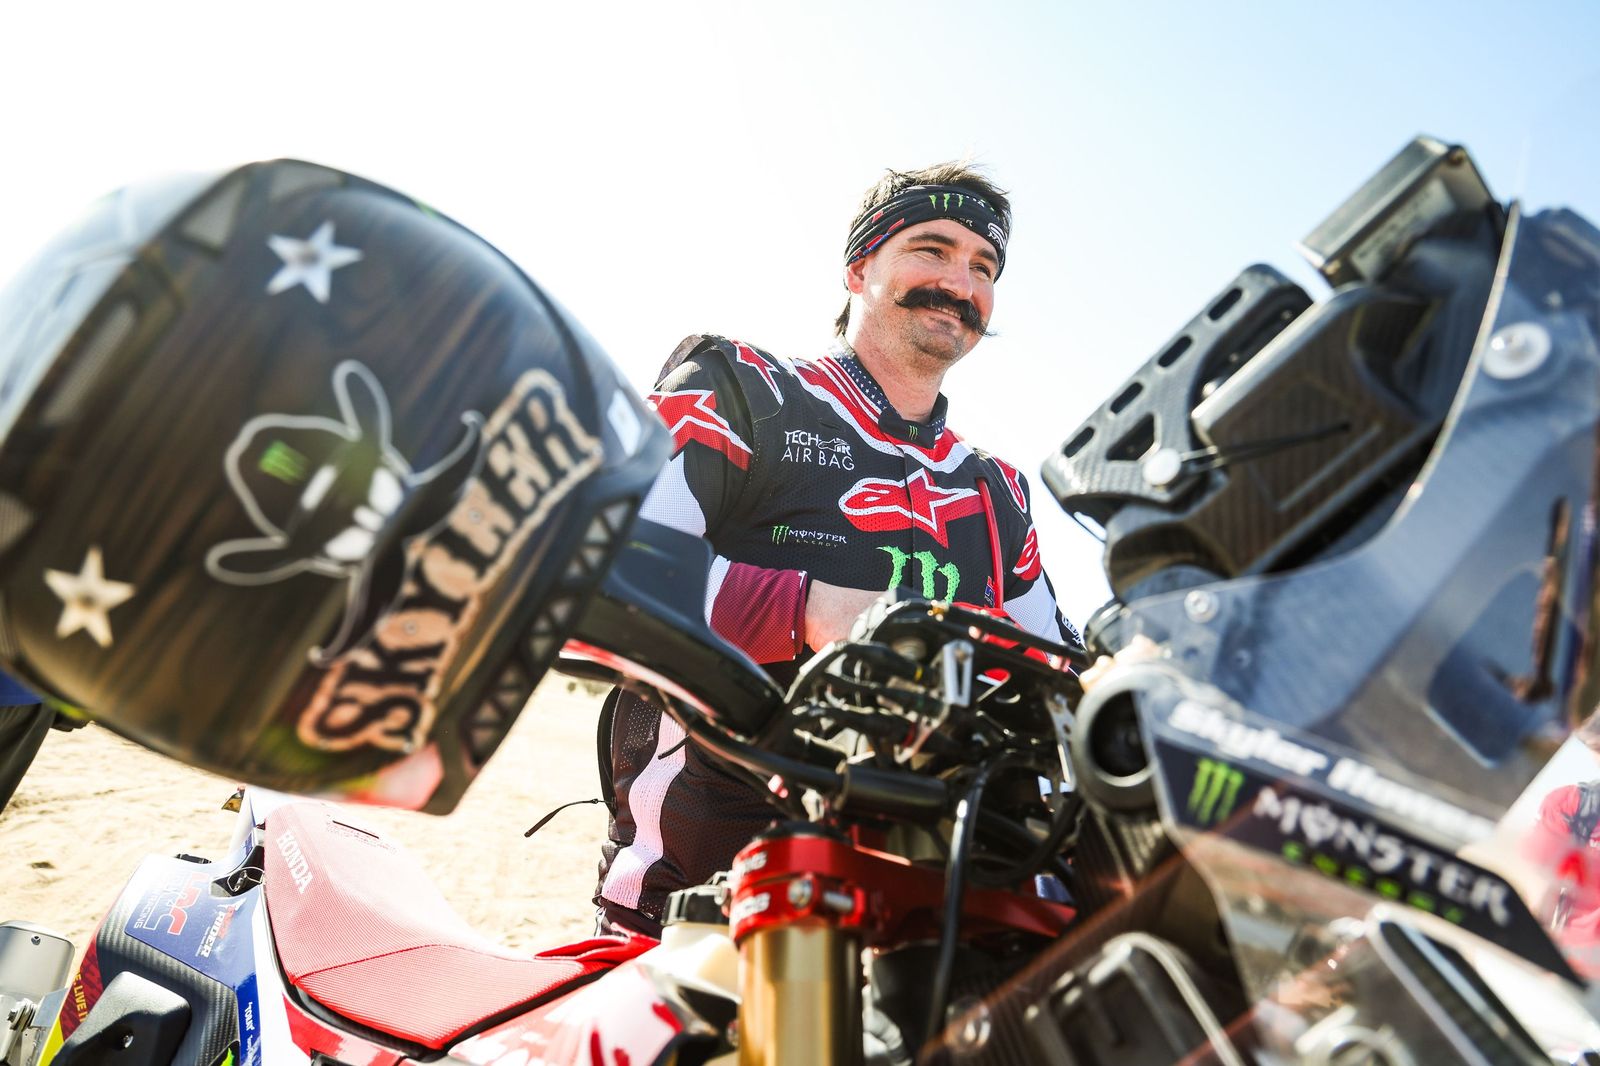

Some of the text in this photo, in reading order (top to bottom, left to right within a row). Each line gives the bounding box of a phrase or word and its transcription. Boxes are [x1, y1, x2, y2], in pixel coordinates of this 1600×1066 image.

[788, 529, 847, 544] MONSTER
[276, 830, 314, 895] HONDA
[1253, 785, 1512, 926] MONSTER
[200, 911, 227, 958] RIDER
[74, 985, 88, 1012] LIVE
